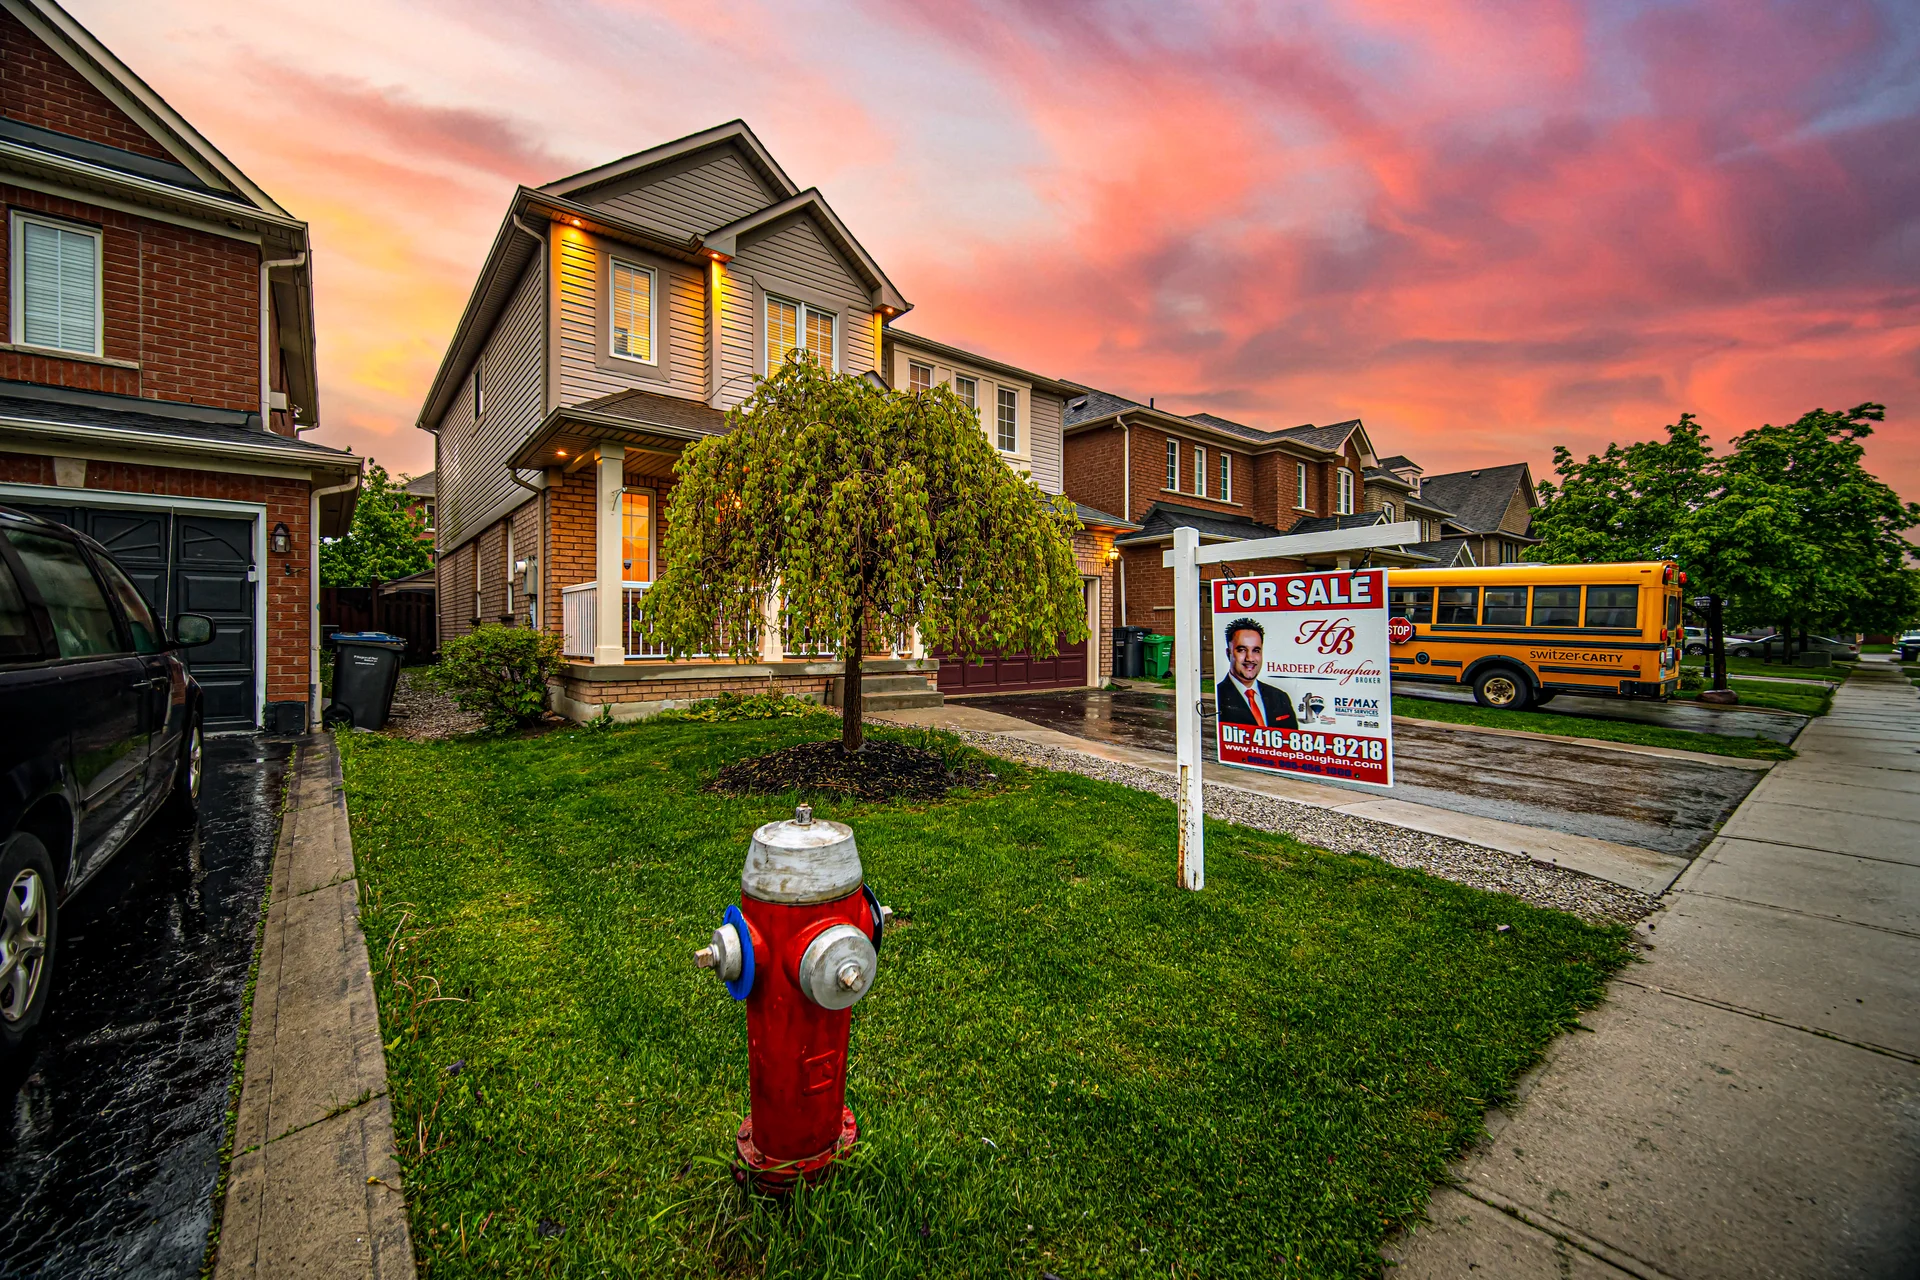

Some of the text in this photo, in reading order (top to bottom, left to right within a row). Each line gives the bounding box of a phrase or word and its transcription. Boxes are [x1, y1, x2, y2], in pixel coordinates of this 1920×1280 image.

[1221, 575, 1372, 608] FOR SALE
[1388, 625, 1410, 636] STOP
[1266, 659, 1382, 686] HARDEEP Boughan
[1355, 676, 1381, 684] BROKER
[1334, 697, 1379, 709] RE/MAX
[1354, 708, 1379, 716] SERVICES
[1222, 724, 1384, 761] Dir: 416-884-8218
[1225, 743, 1383, 770] www.HardeepBoughan.com
